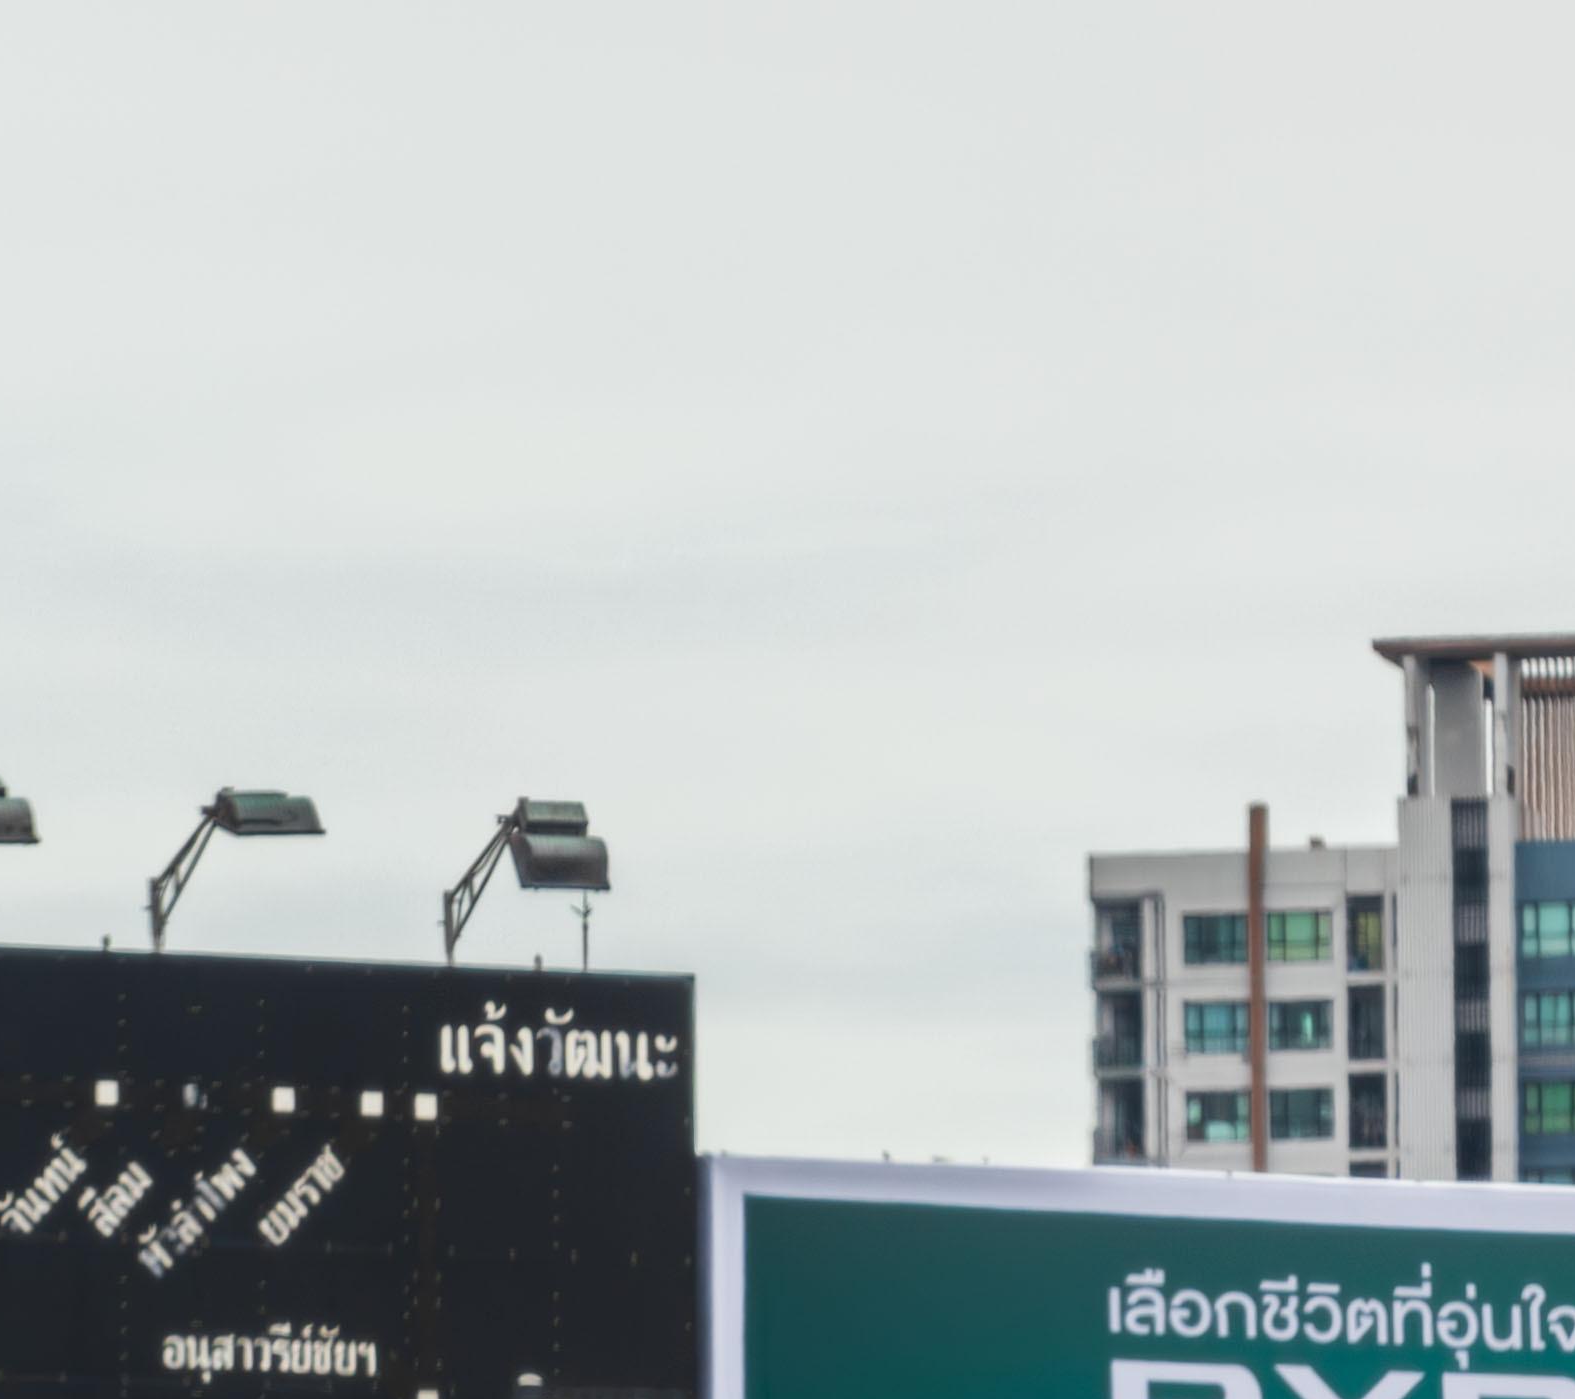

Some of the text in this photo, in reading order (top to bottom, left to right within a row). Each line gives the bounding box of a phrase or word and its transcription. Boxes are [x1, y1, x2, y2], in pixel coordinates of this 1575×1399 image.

[440, 1000, 678, 1081] แจ้งวัฒนะ
[78, 1162, 153, 1237] สีลม
[258, 1144, 345, 1246] ยมราช
[162, 1322, 376, 1384] อนุสาวรีย์ชัยฯ
